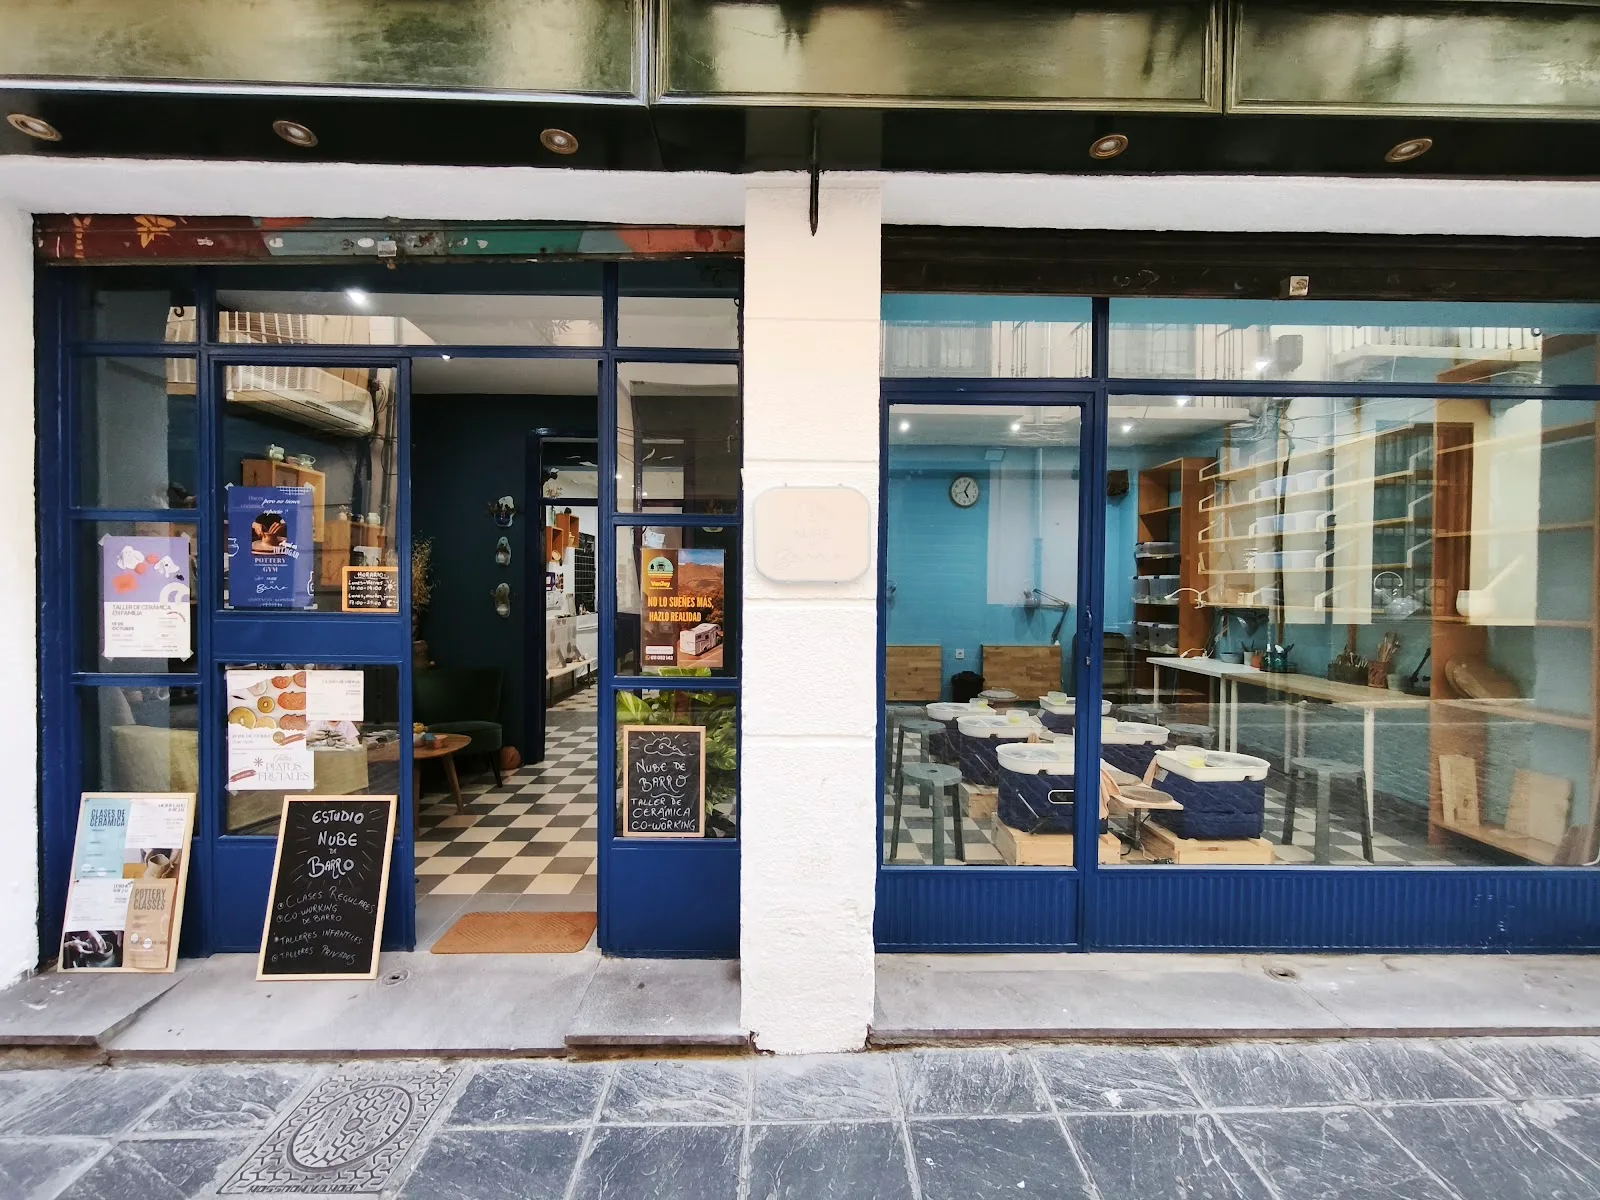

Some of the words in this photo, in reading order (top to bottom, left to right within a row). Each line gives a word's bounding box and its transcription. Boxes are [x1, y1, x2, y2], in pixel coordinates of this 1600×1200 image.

[261, 498, 276, 506] pero
[141, 603, 172, 611] CERÁMICA
[647, 596, 658, 608] NO
[659, 596, 668, 608] LO
[669, 594, 696, 608] SUEÑES
[696, 595, 714, 609] MÁS,
[649, 612, 670, 622] HAZLO
[670, 612, 702, 622] REALIDAD
[265, 762, 302, 772] PLATOS
[636, 758, 668, 774] NUBE
[673, 761, 687, 771] DE
[258, 772, 311, 781] FRUTALES
[638, 773, 692, 793] BARRO
[631, 797, 666, 806] TALLER
[671, 797, 682, 806] DE
[90, 808, 117, 819] CLASES
[117, 808, 125, 818] DE
[312, 809, 365, 825] ESTUDIO
[632, 805, 691, 818] CERÁMICA
[317, 831, 358, 847] NUBE
[307, 855, 355, 880] BARRO
[134, 888, 167, 900] POTTERY
[285, 891, 323, 908] CLASES
[328, 885, 376, 914] REGULARES
[133, 899, 166, 911] CLASSES
[312, 914, 343, 923] BARRO
[279, 931, 318, 946] TALLERES
[322, 928, 363, 945] INFANTILES
[279, 946, 314, 959] TALLERES
[321, 944, 356, 966] PRIVADOS
